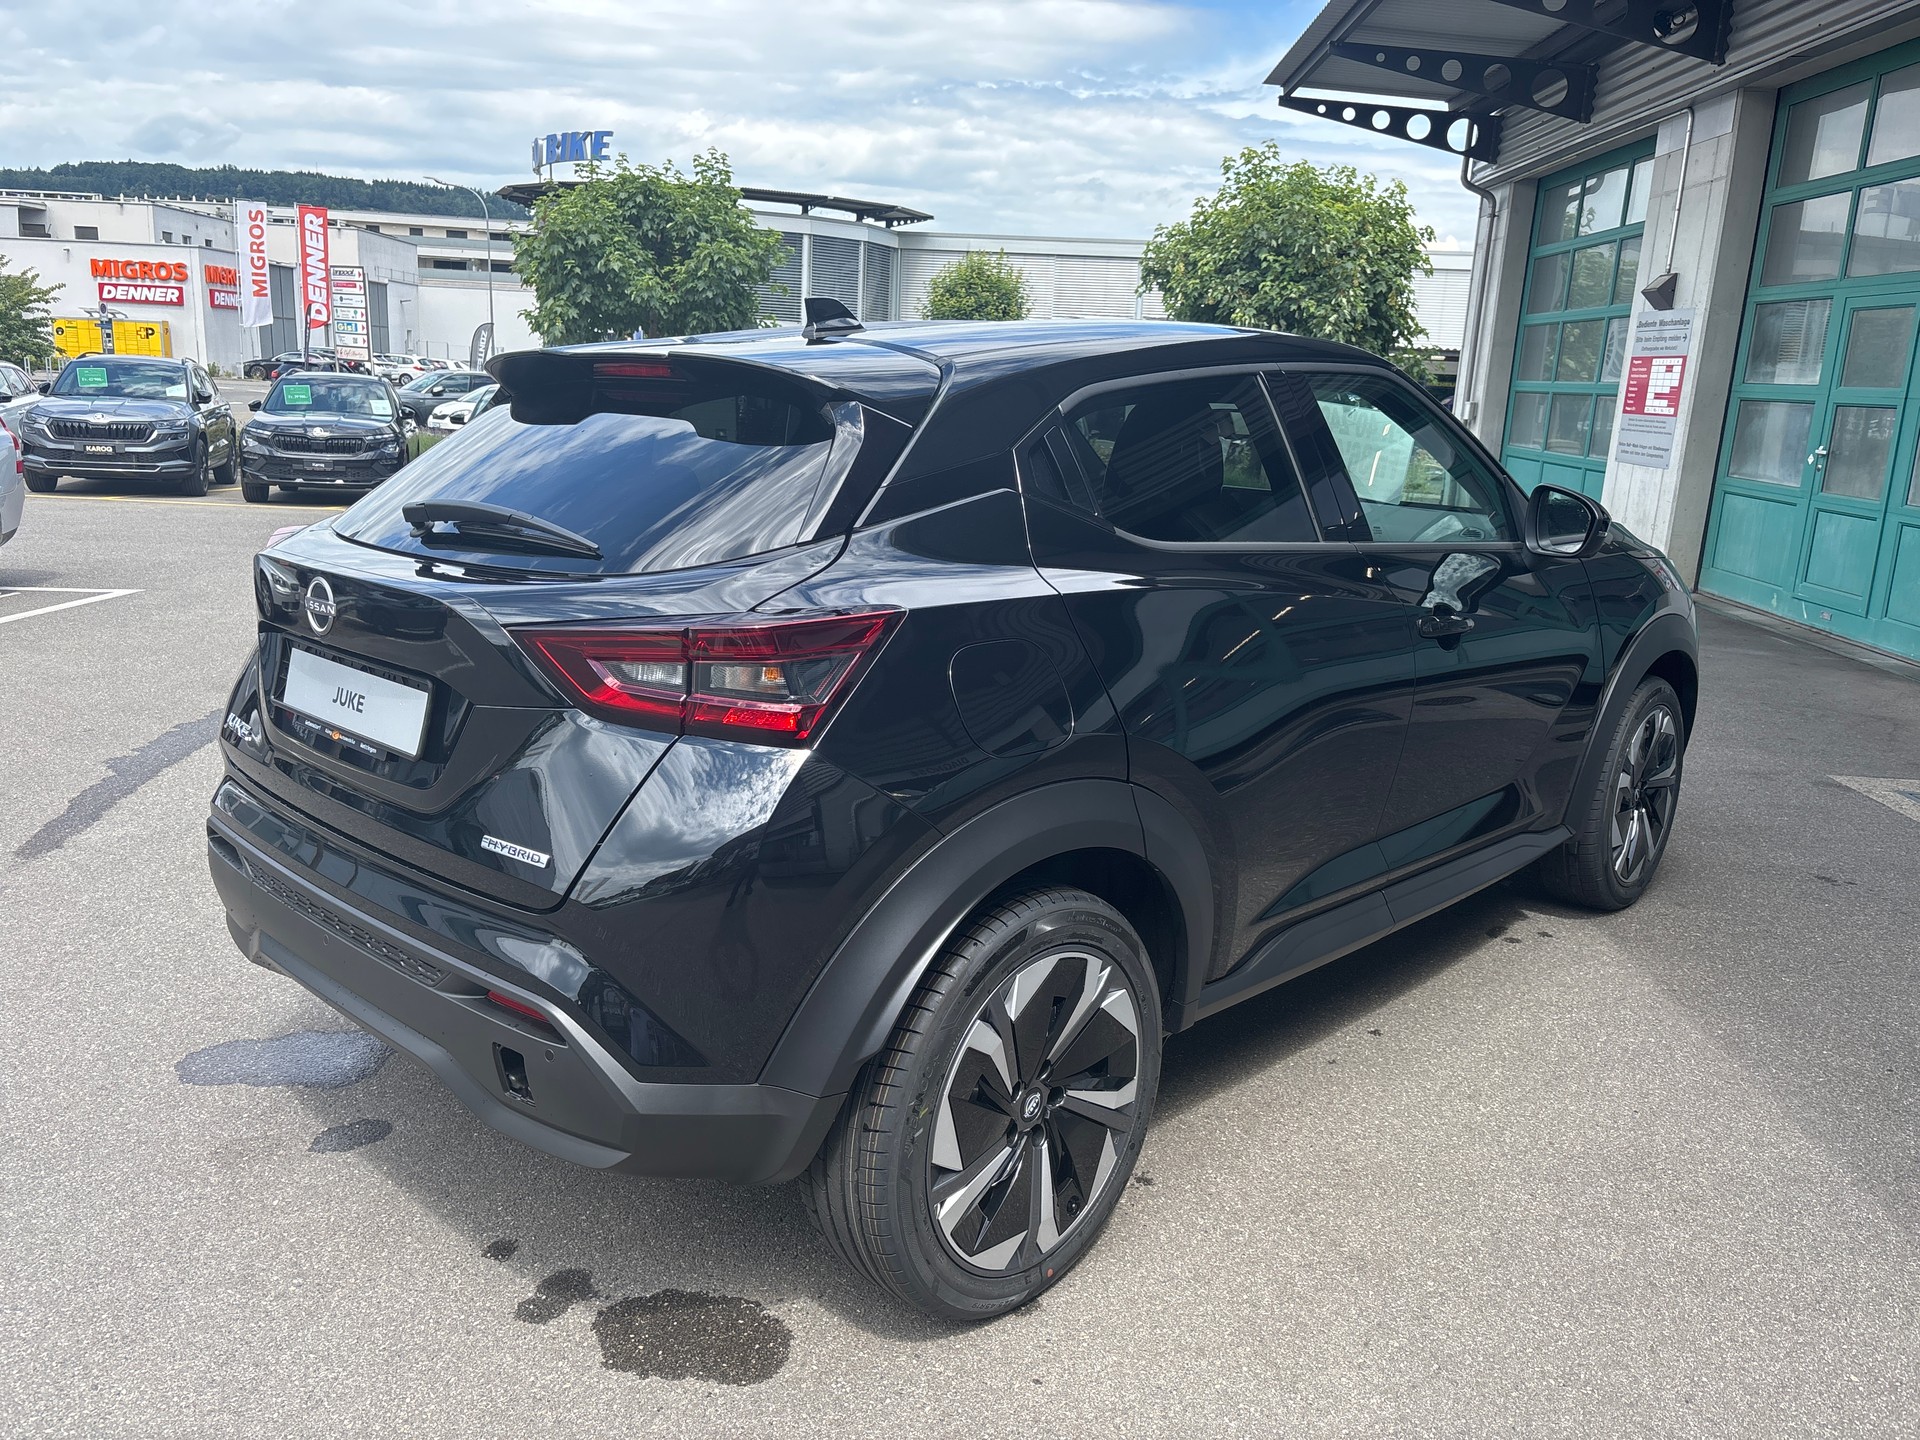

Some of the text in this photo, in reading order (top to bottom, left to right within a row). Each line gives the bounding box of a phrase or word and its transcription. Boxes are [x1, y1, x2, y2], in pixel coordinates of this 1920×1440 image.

[546, 131, 614, 164] BIKE
[248, 209, 269, 298] MIGROS
[304, 213, 327, 321] DENNER
[90, 258, 188, 282] MIGROS
[102, 285, 179, 302] DENNER
[86, 445, 113, 453] KAROQ
[332, 686, 366, 714] JUKE
[486, 837, 542, 865] HYBRID
